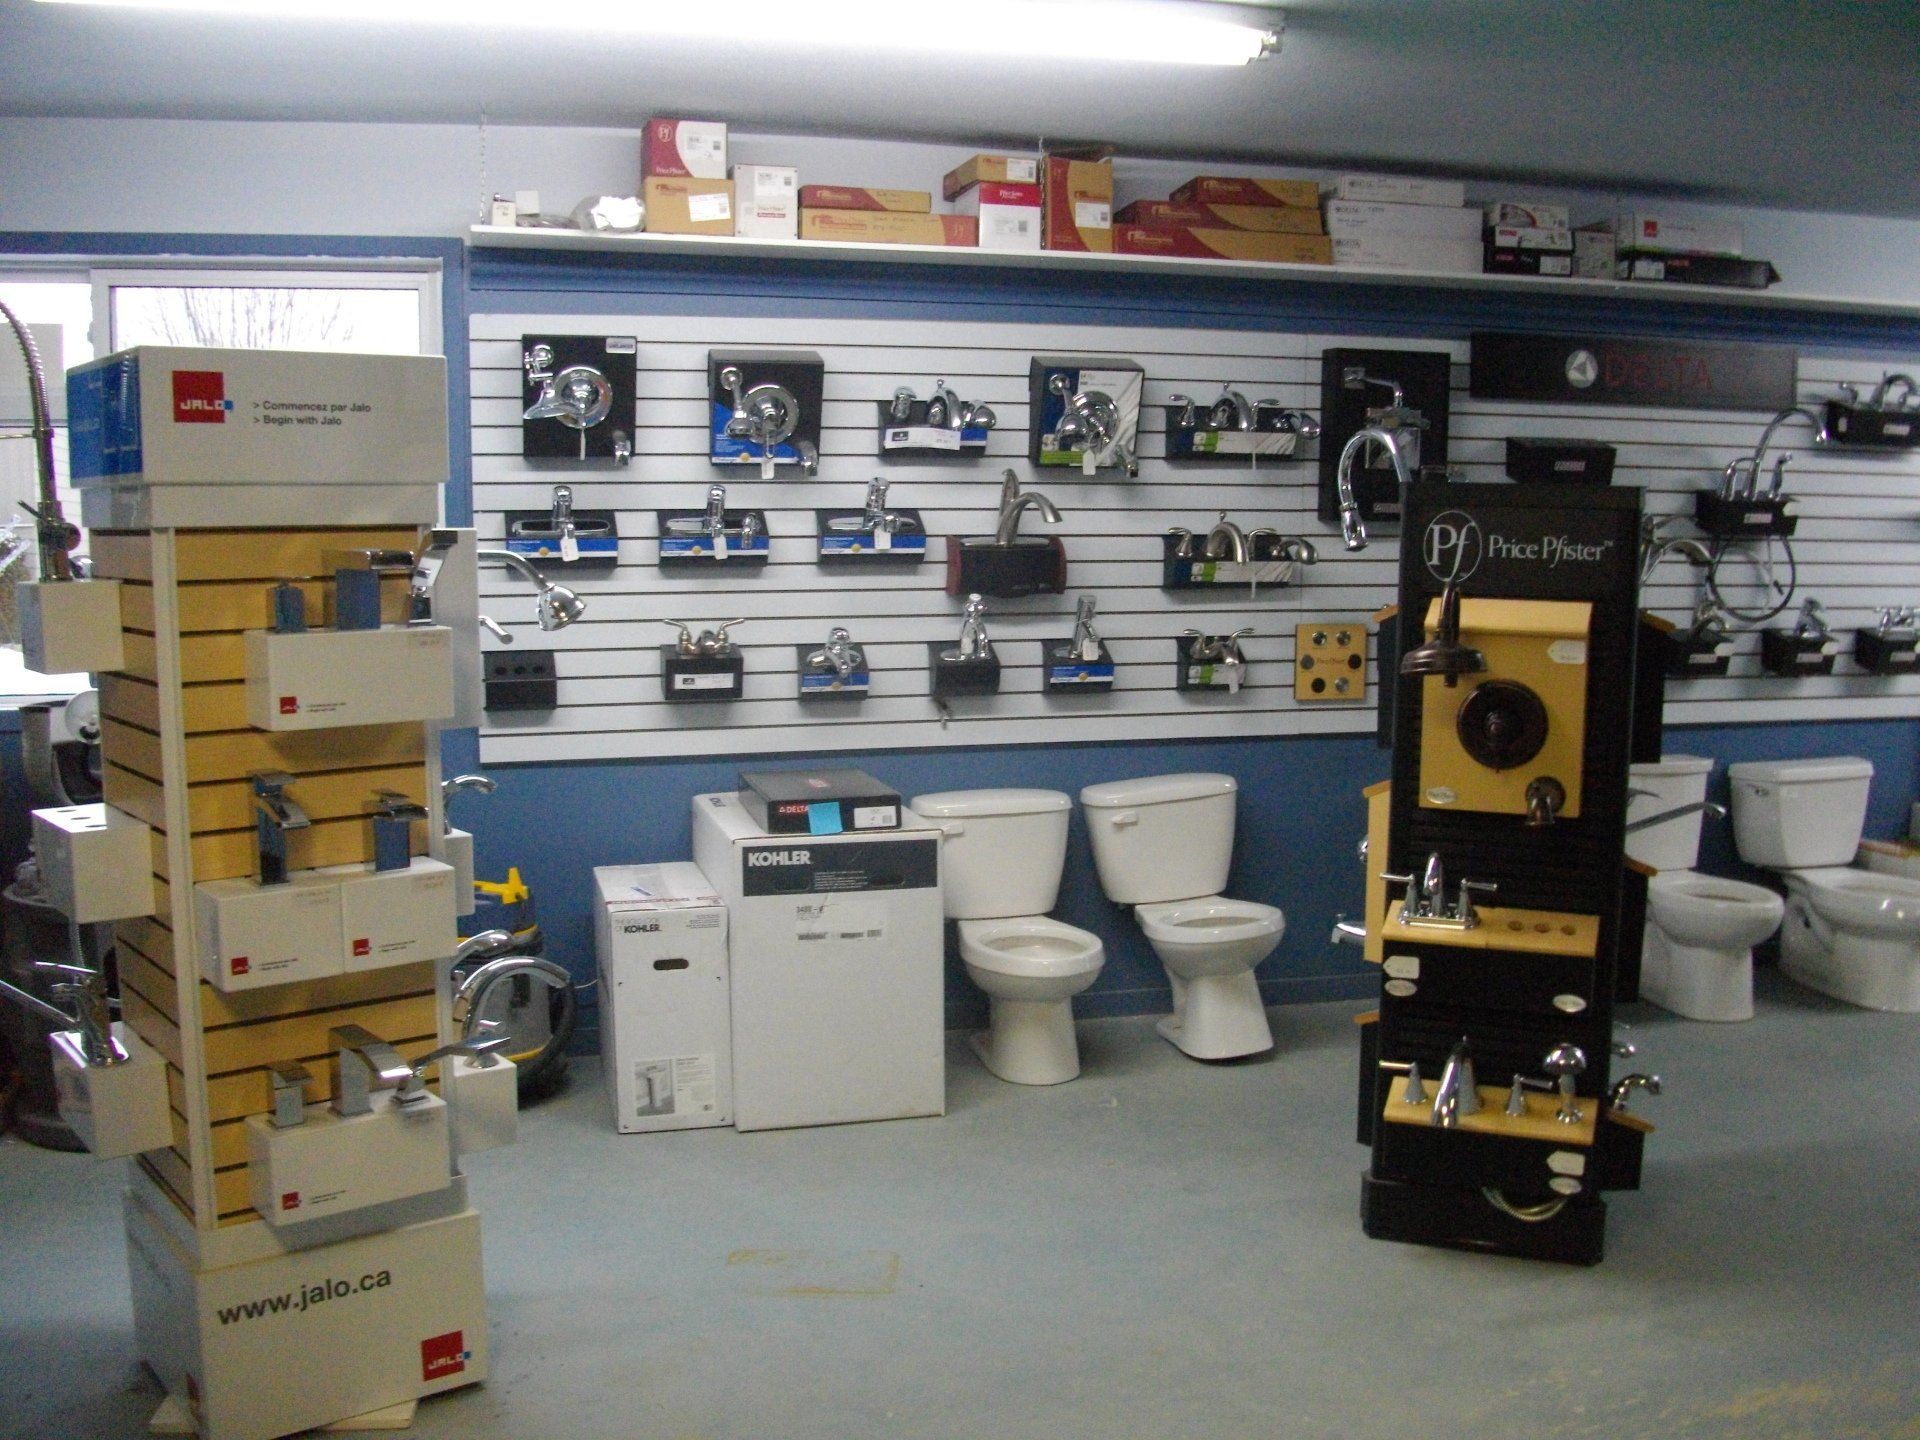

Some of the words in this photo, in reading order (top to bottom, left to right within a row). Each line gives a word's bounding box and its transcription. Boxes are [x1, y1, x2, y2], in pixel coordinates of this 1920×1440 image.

[1604, 352, 1714, 391] DELTA
[263, 401, 327, 412] Commencez
[330, 403, 348, 413] par
[350, 403, 372, 413] Jalo
[264, 415, 294, 426] Begin
[297, 416, 318, 426] with
[321, 416, 342, 426] Jalo
[1488, 535, 1538, 559] Price
[748, 850, 811, 867] KOHLER
[217, 1270, 392, 1325] www.jalo.ca
